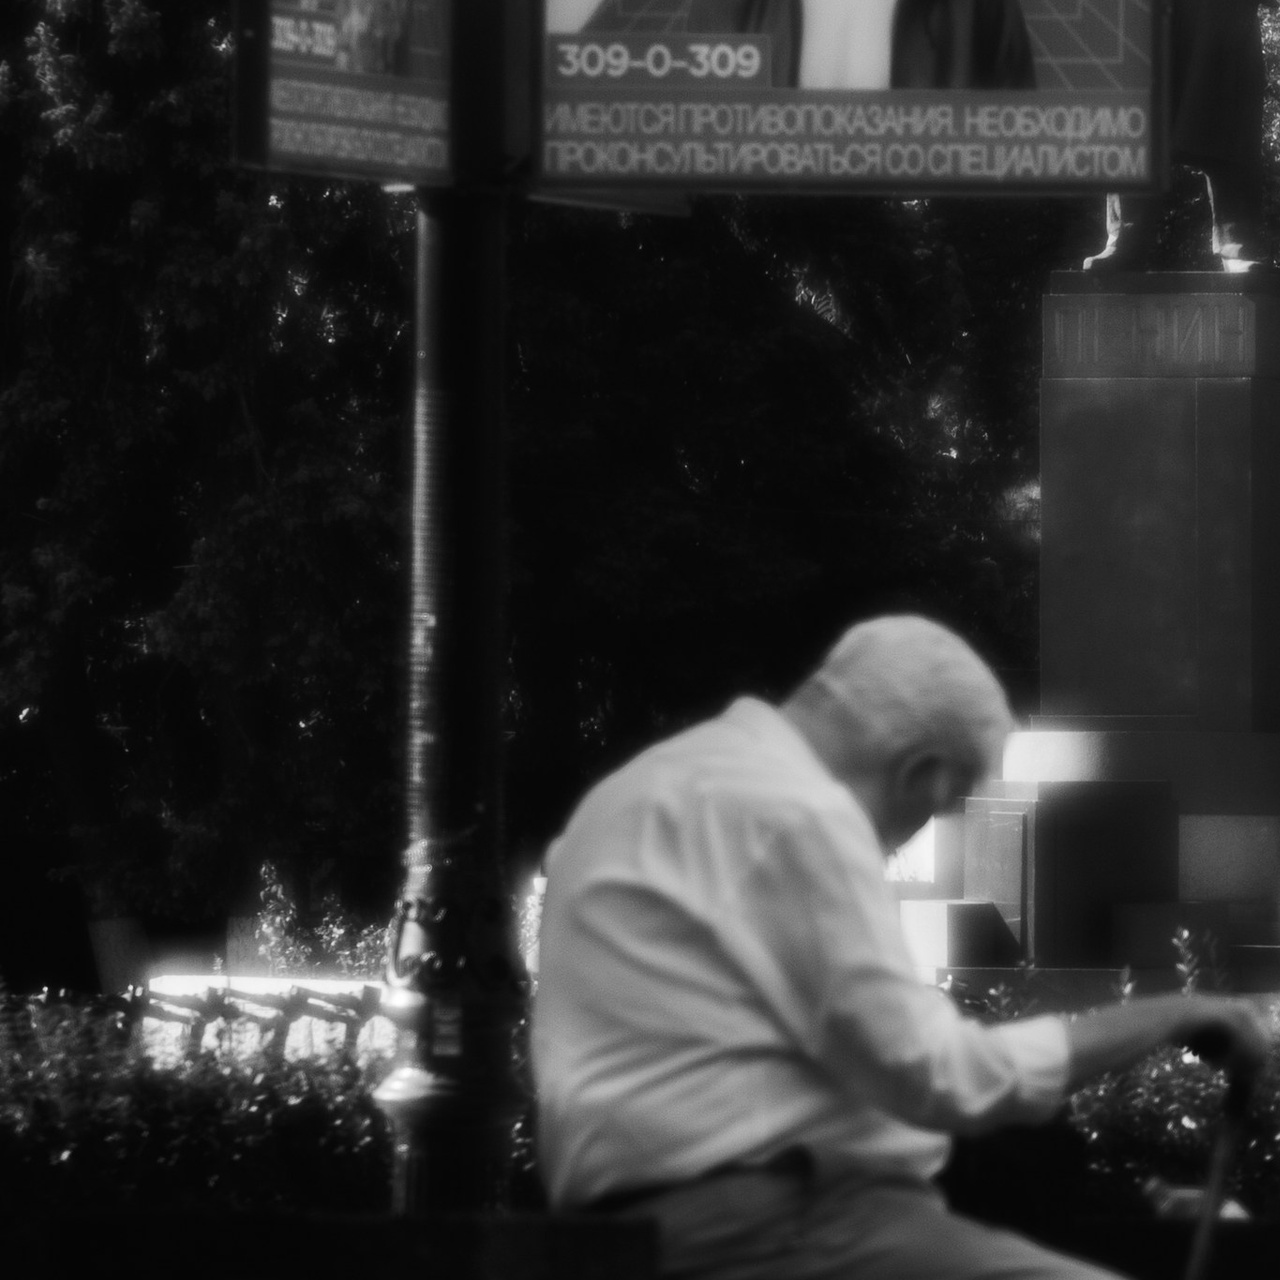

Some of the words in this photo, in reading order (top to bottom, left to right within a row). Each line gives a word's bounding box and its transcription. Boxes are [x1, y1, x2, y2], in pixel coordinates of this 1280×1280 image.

[556, 41, 762, 80] 309-0-309
[544, 101, 676, 135] ИМЕЮТСЯ
[679, 102, 957, 137] ПРОТИВОПОКАЗАНИЯ.
[964, 104, 1146, 142] НЕОБХОДИМО
[544, 140, 882, 175] ПРОКОНСУЛЬТИРОВАТЬСЯ
[886, 142, 925, 176] СО
[928, 143, 1147, 179] СПЕЦИАЛИСТОМ
